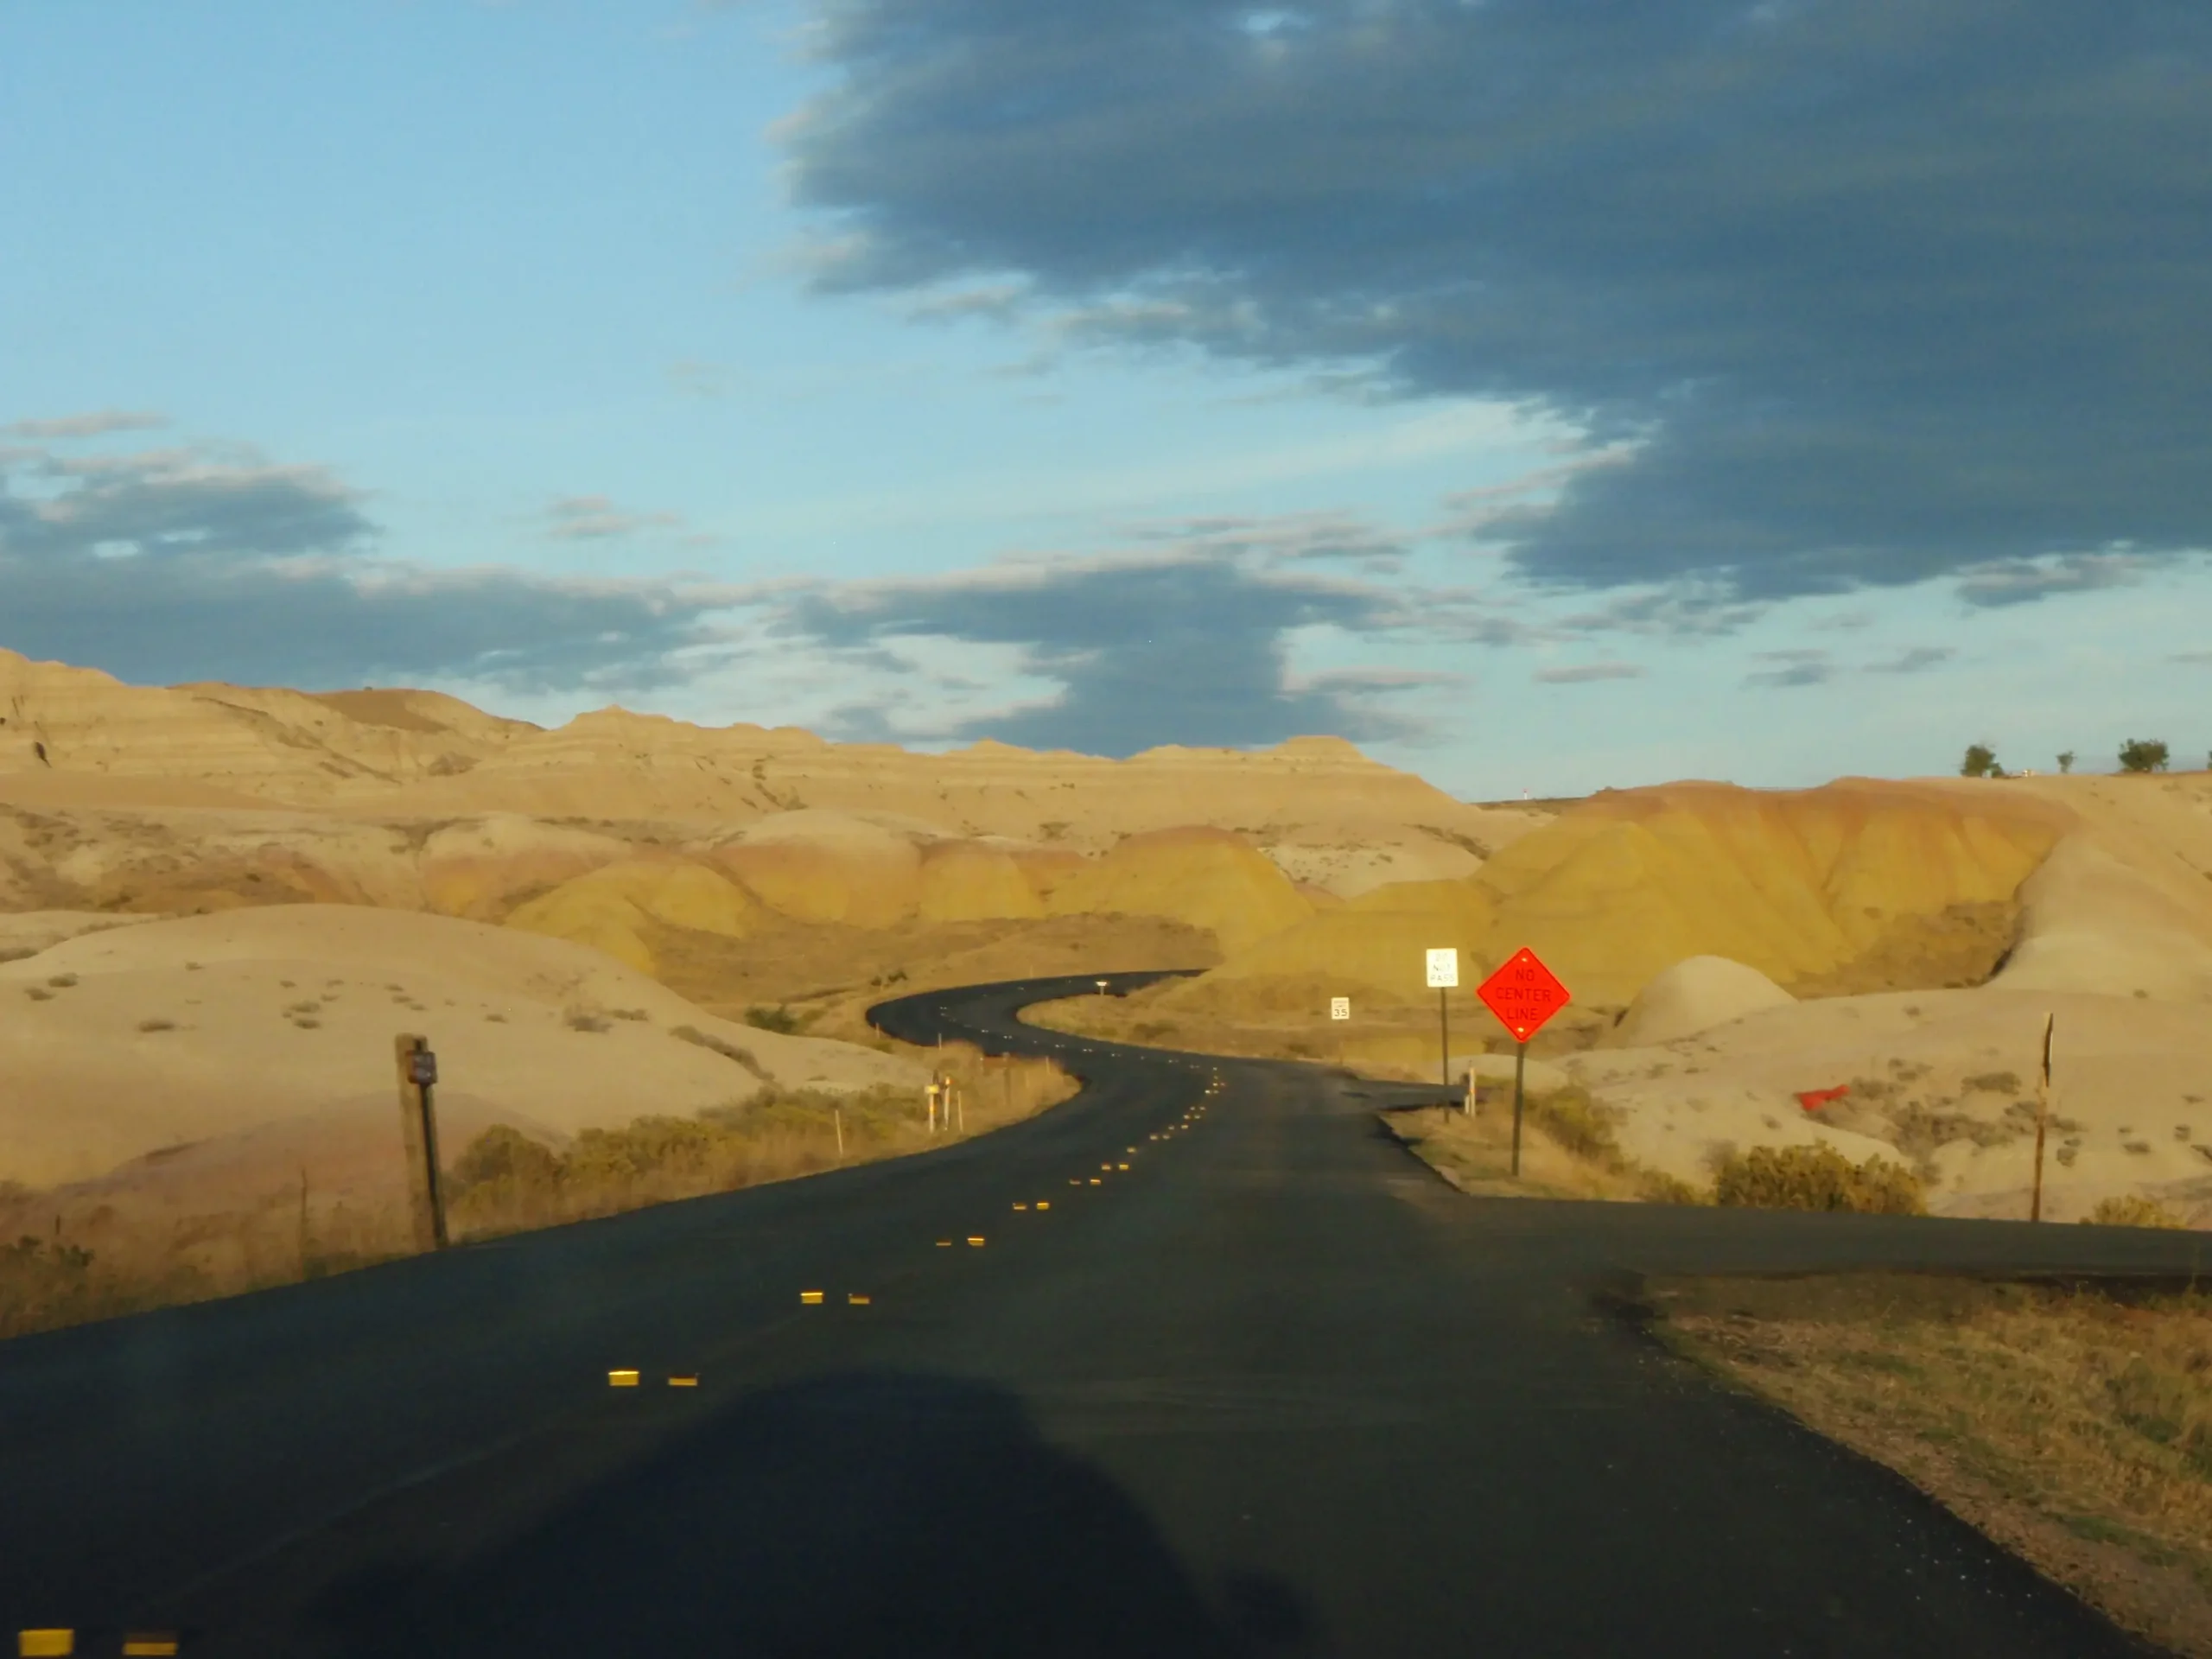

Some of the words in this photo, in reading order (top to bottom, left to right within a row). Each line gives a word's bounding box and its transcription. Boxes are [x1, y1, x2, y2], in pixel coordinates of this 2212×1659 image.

[1516, 968, 1535, 982] NO
[1496, 987, 1552, 1002] CENTER
[1334, 1008, 1348, 1017] 35
[1507, 1007, 1538, 1020] LINE
